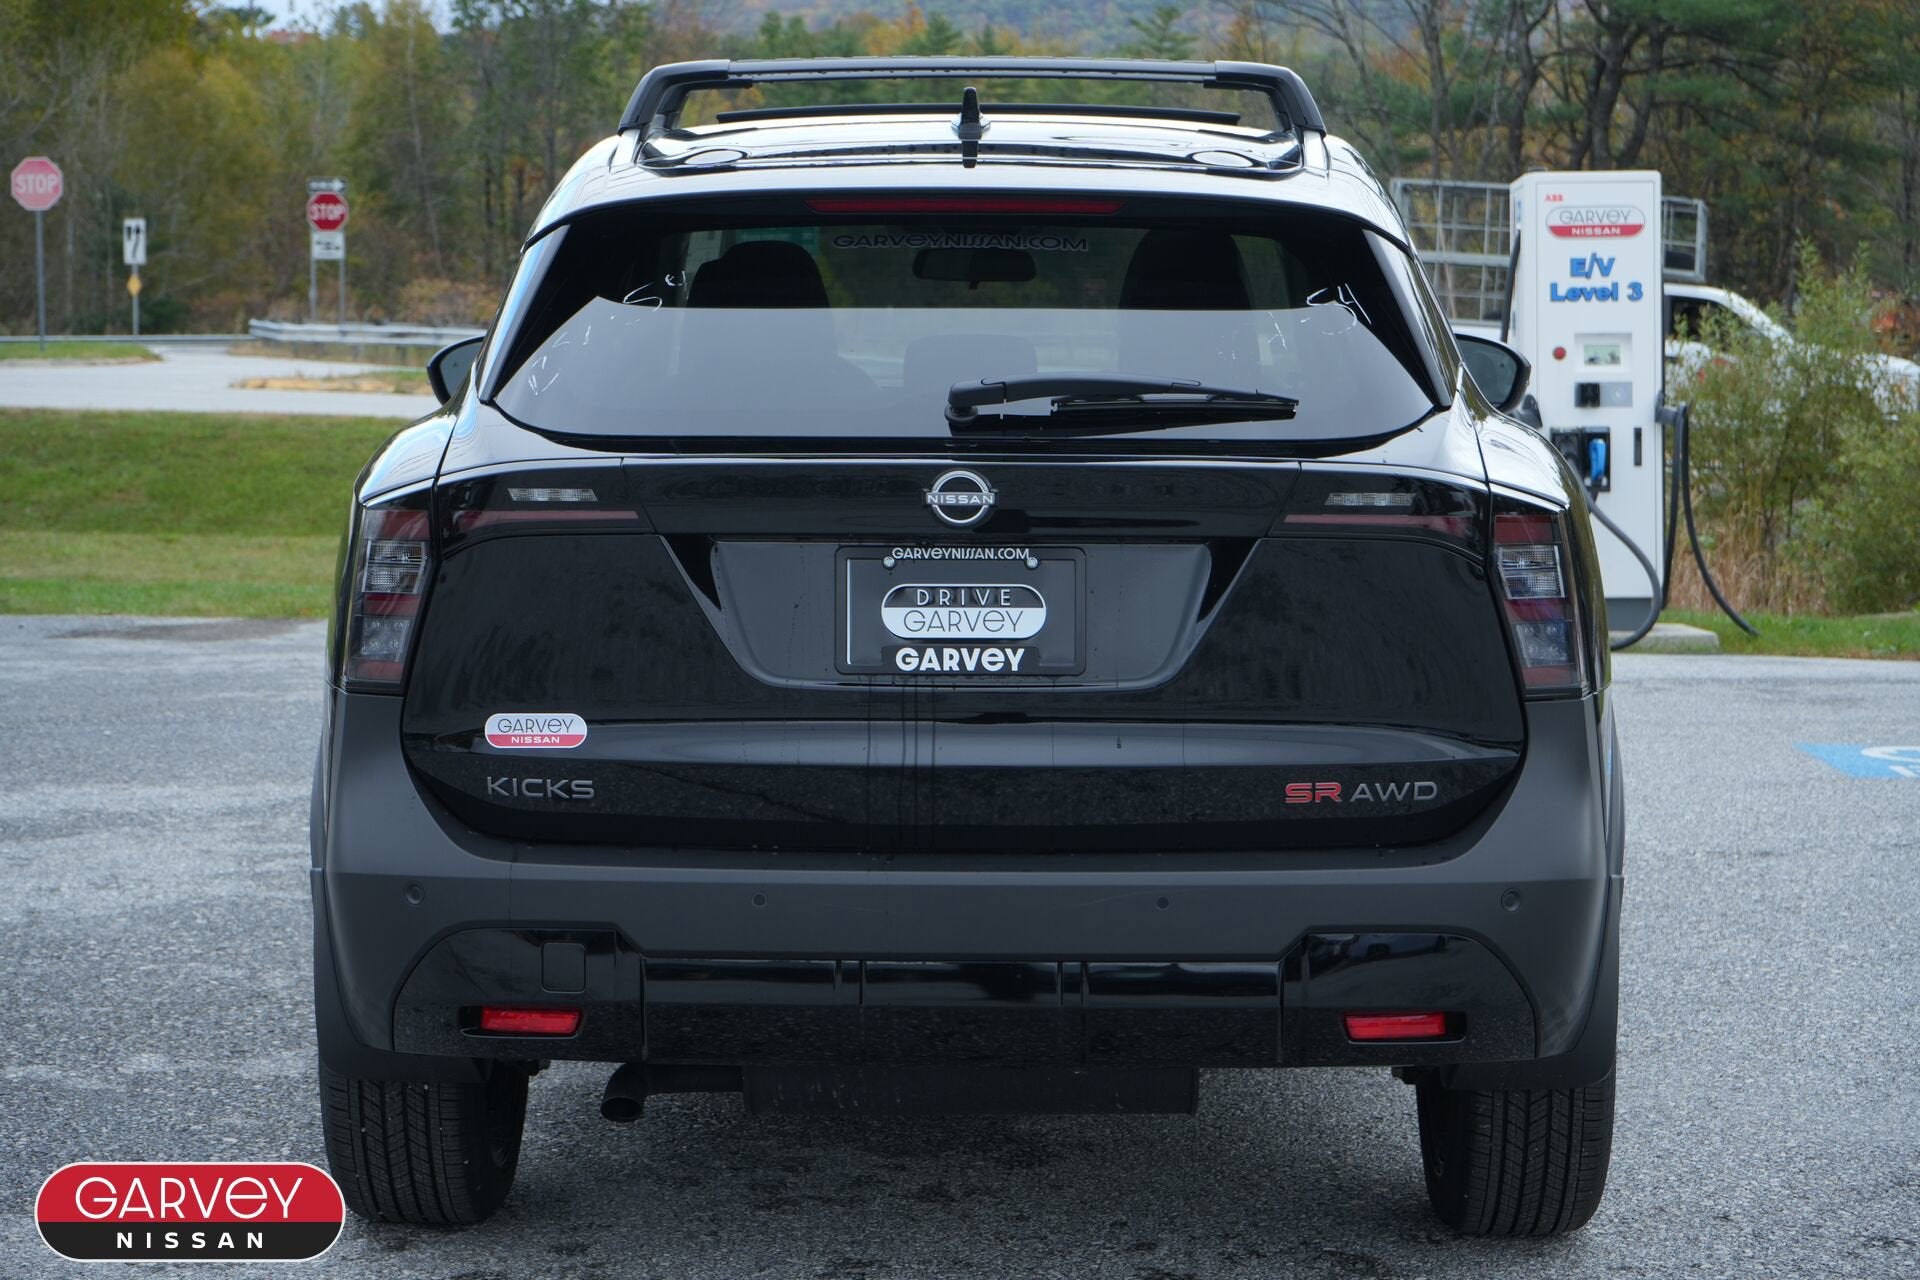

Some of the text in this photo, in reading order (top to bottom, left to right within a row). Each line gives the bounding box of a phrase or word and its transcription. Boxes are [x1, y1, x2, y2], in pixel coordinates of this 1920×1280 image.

[16, 174, 59, 193] STOP
[1545, 194, 1563, 202] ABB
[310, 203, 345, 221] STOP
[1571, 226, 1621, 236] NISSAN
[1570, 252, 1616, 279] E/V
[1550, 281, 1643, 302] Level 3
[926, 493, 995, 504] NISSAN
[916, 589, 1011, 606] DRIVE
[511, 736, 560, 744] NISSAN
[487, 776, 595, 799] KICKS
[1285, 781, 1438, 803] SR AWD
